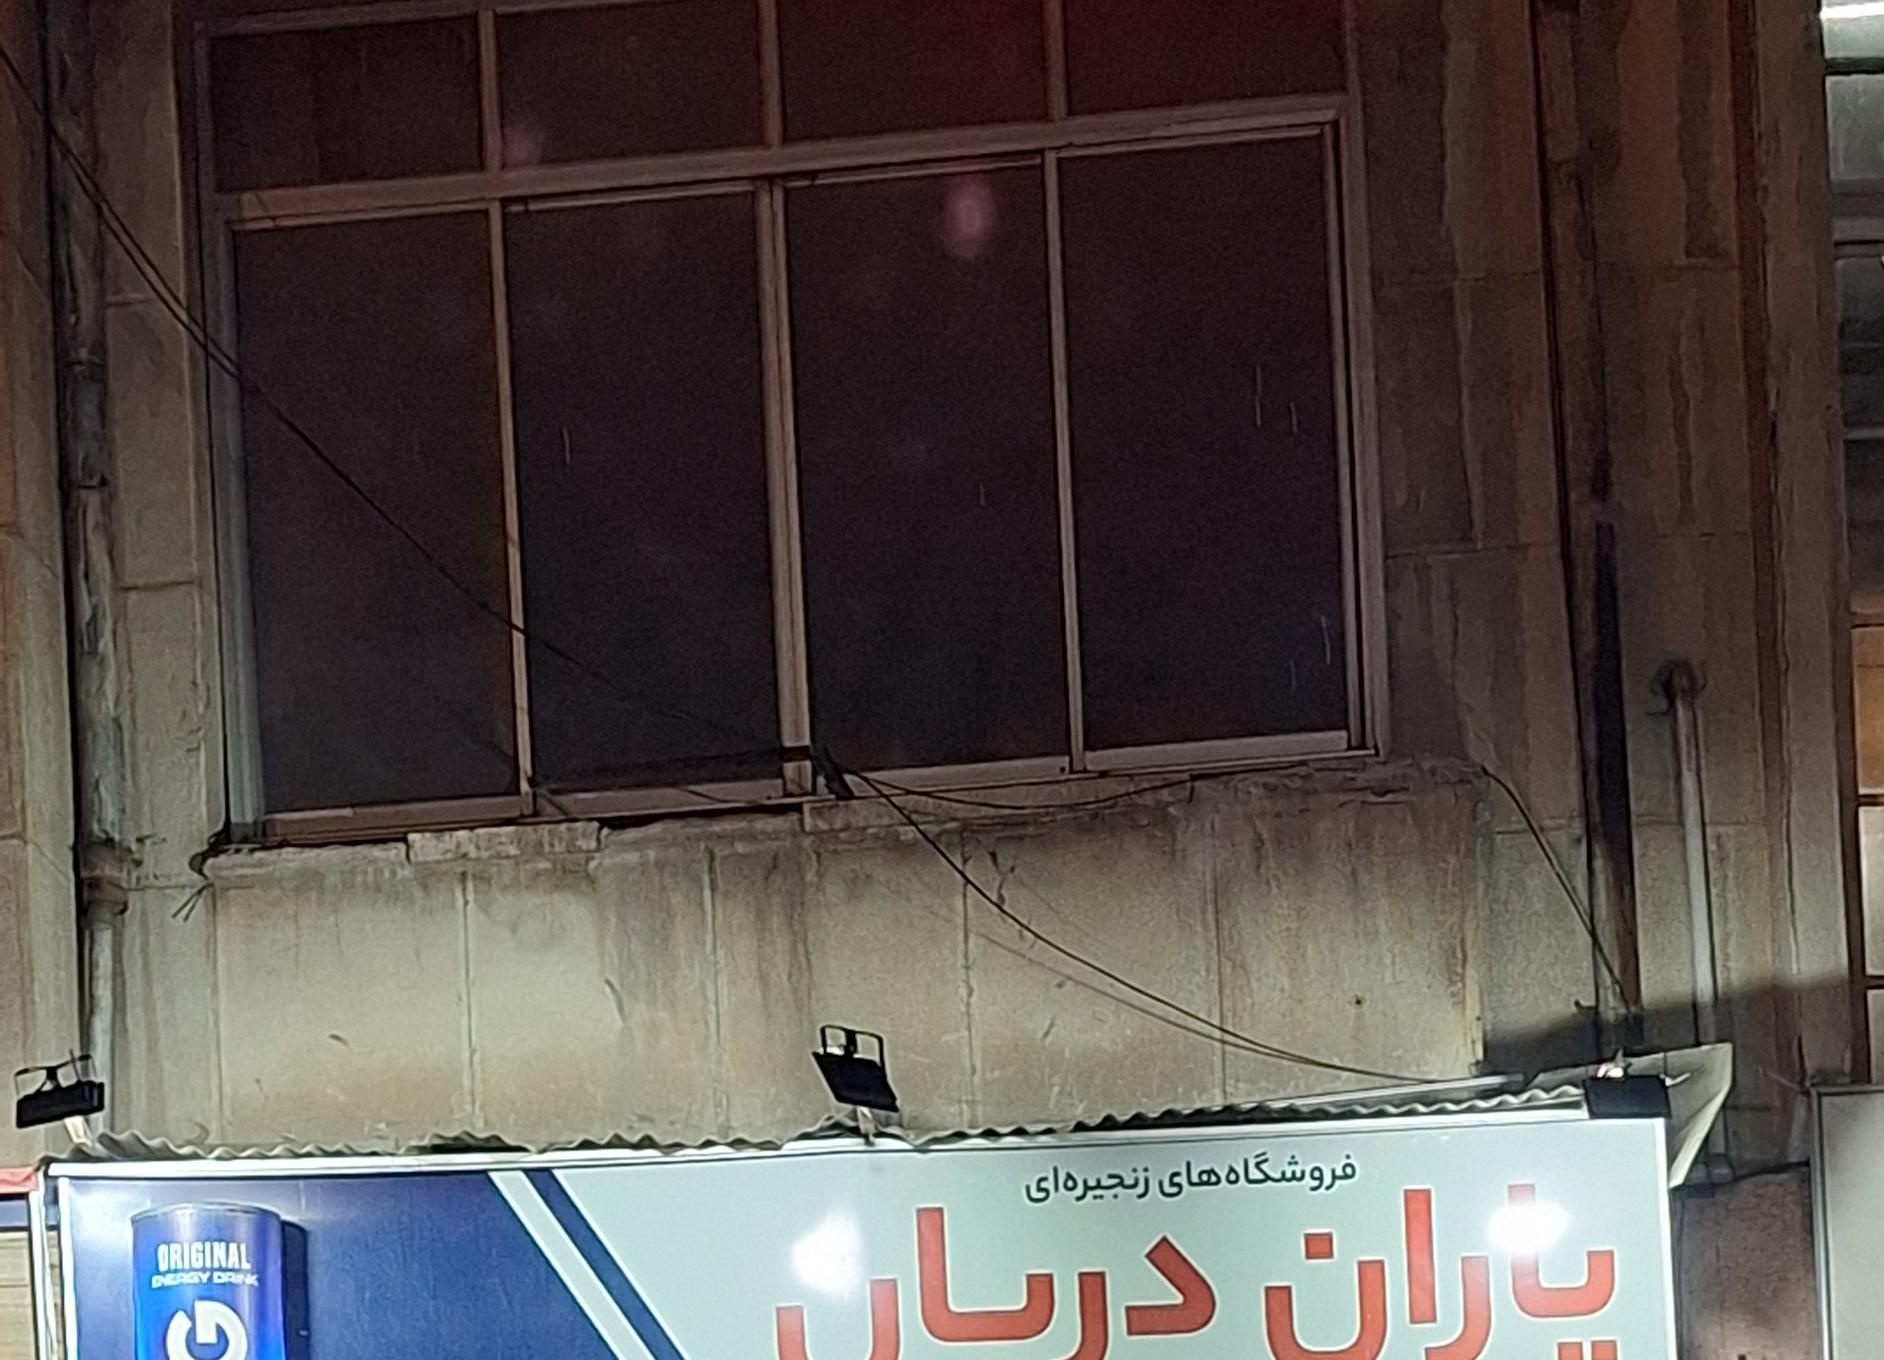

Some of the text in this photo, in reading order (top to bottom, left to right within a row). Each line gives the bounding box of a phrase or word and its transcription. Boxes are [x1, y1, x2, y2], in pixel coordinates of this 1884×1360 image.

[157, 1240, 251, 1272] ORIGINAL
[151, 1271, 259, 1289] ENERGY DRINK
